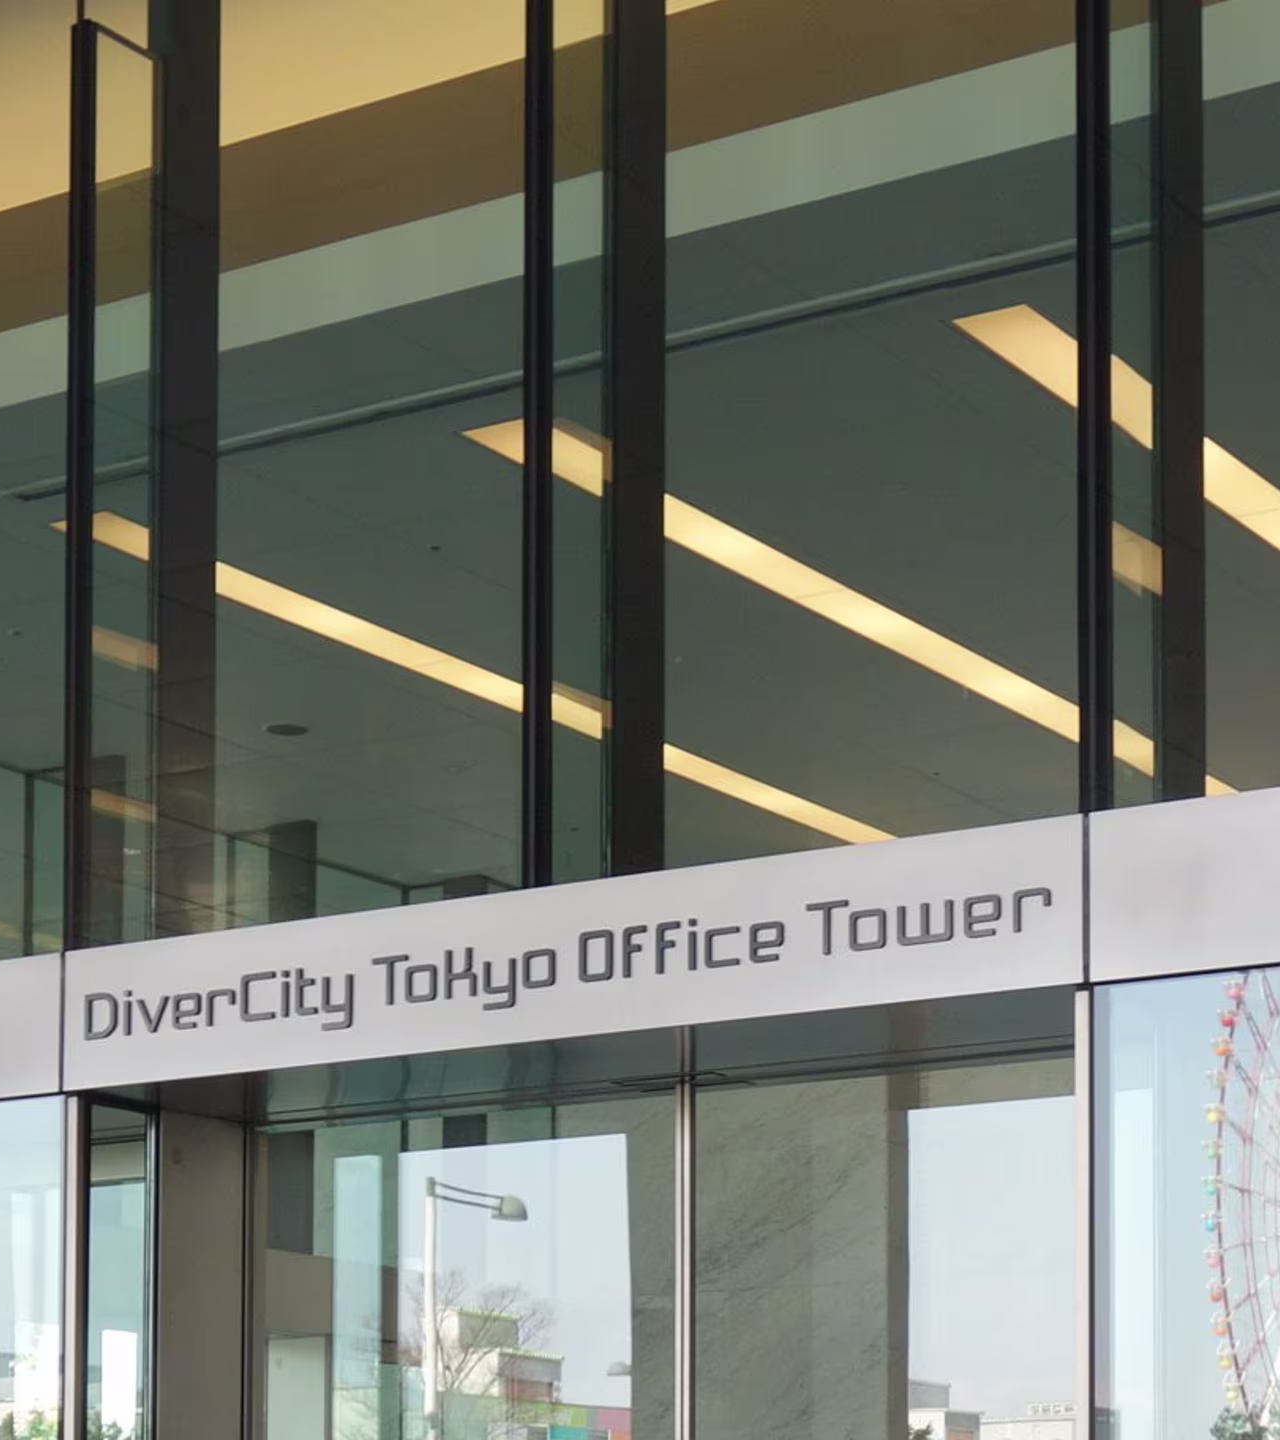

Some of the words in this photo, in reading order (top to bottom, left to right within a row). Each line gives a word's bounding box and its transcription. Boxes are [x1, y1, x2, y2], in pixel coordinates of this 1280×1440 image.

[83, 967, 355, 1041] DiverCity
[371, 946, 558, 1012] Tokyo
[577, 917, 786, 983] Office
[806, 886, 1053, 957] Tower
